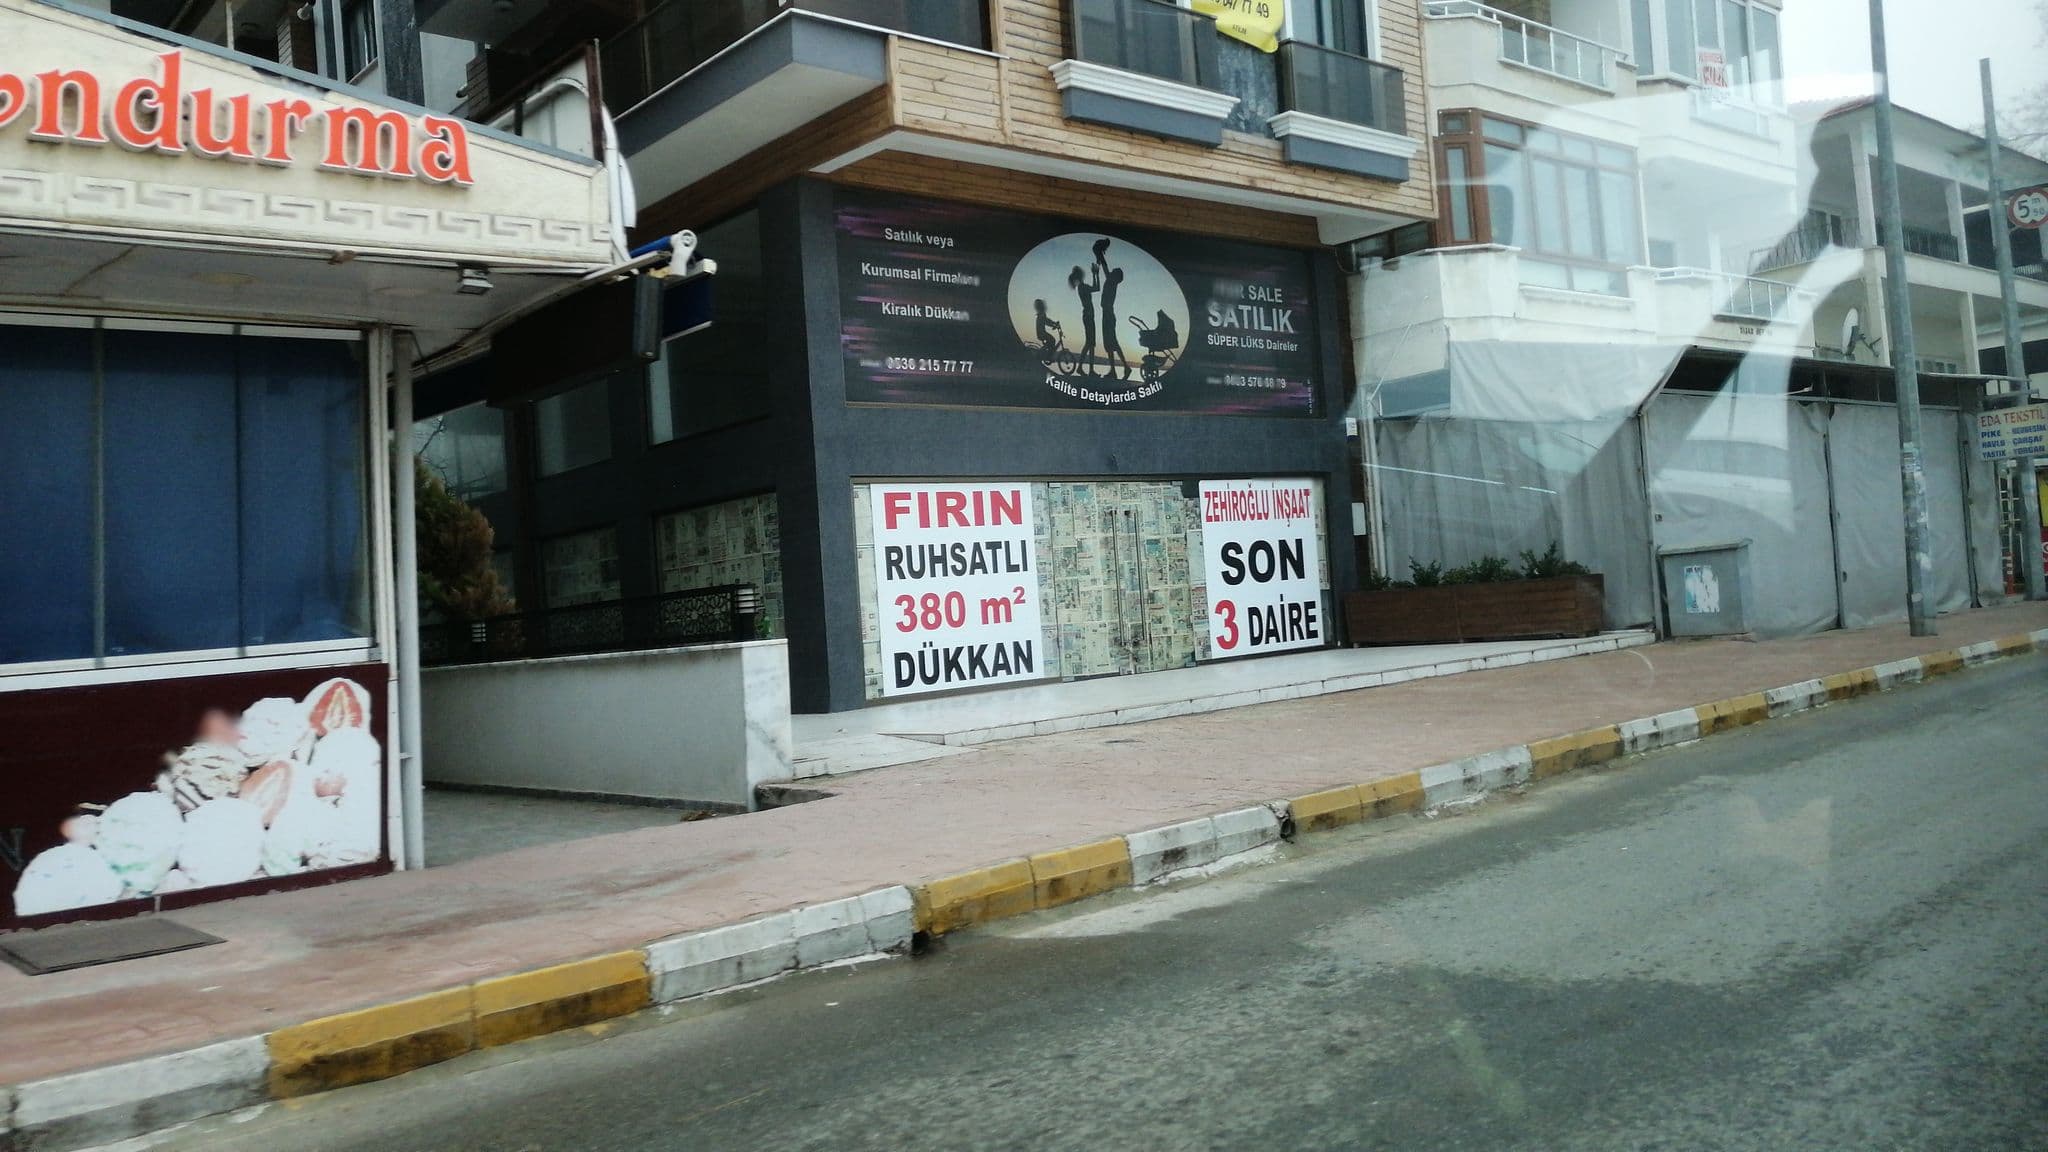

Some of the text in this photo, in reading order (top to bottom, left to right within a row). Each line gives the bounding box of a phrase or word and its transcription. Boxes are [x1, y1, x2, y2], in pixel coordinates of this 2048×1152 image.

[1256, 2, 1270, 18] 49
[2018, 199, 2030, 218] 5
[885, 228, 954, 248] Satılık veya
[861, 262, 921, 280] Kurumsal
[1248, 285, 1283, 303] SALE
[925, 305, 970, 320] Dükka
[1208, 301, 1294, 333] SATILIK
[1207, 333, 1298, 351] SÜPER LÜKS Daireler
[919, 359, 940, 372] 215
[943, 360, 957, 372] 77
[960, 361, 974, 373] 77
[1045, 374, 1163, 405] Kalite Detaylarda Saklı
[1981, 415, 2001, 428] EDA
[883, 490, 1022, 530] FIRIN
[1204, 482, 1311, 527] ZEHİROĞLU İNŞAAT
[884, 539, 1028, 580] RUHSATLI
[1221, 538, 1305, 585] SON
[895, 590, 966, 633] 380
[1215, 593, 1319, 650] 3 DAİRE
[893, 640, 1034, 689] DÜKKAN
